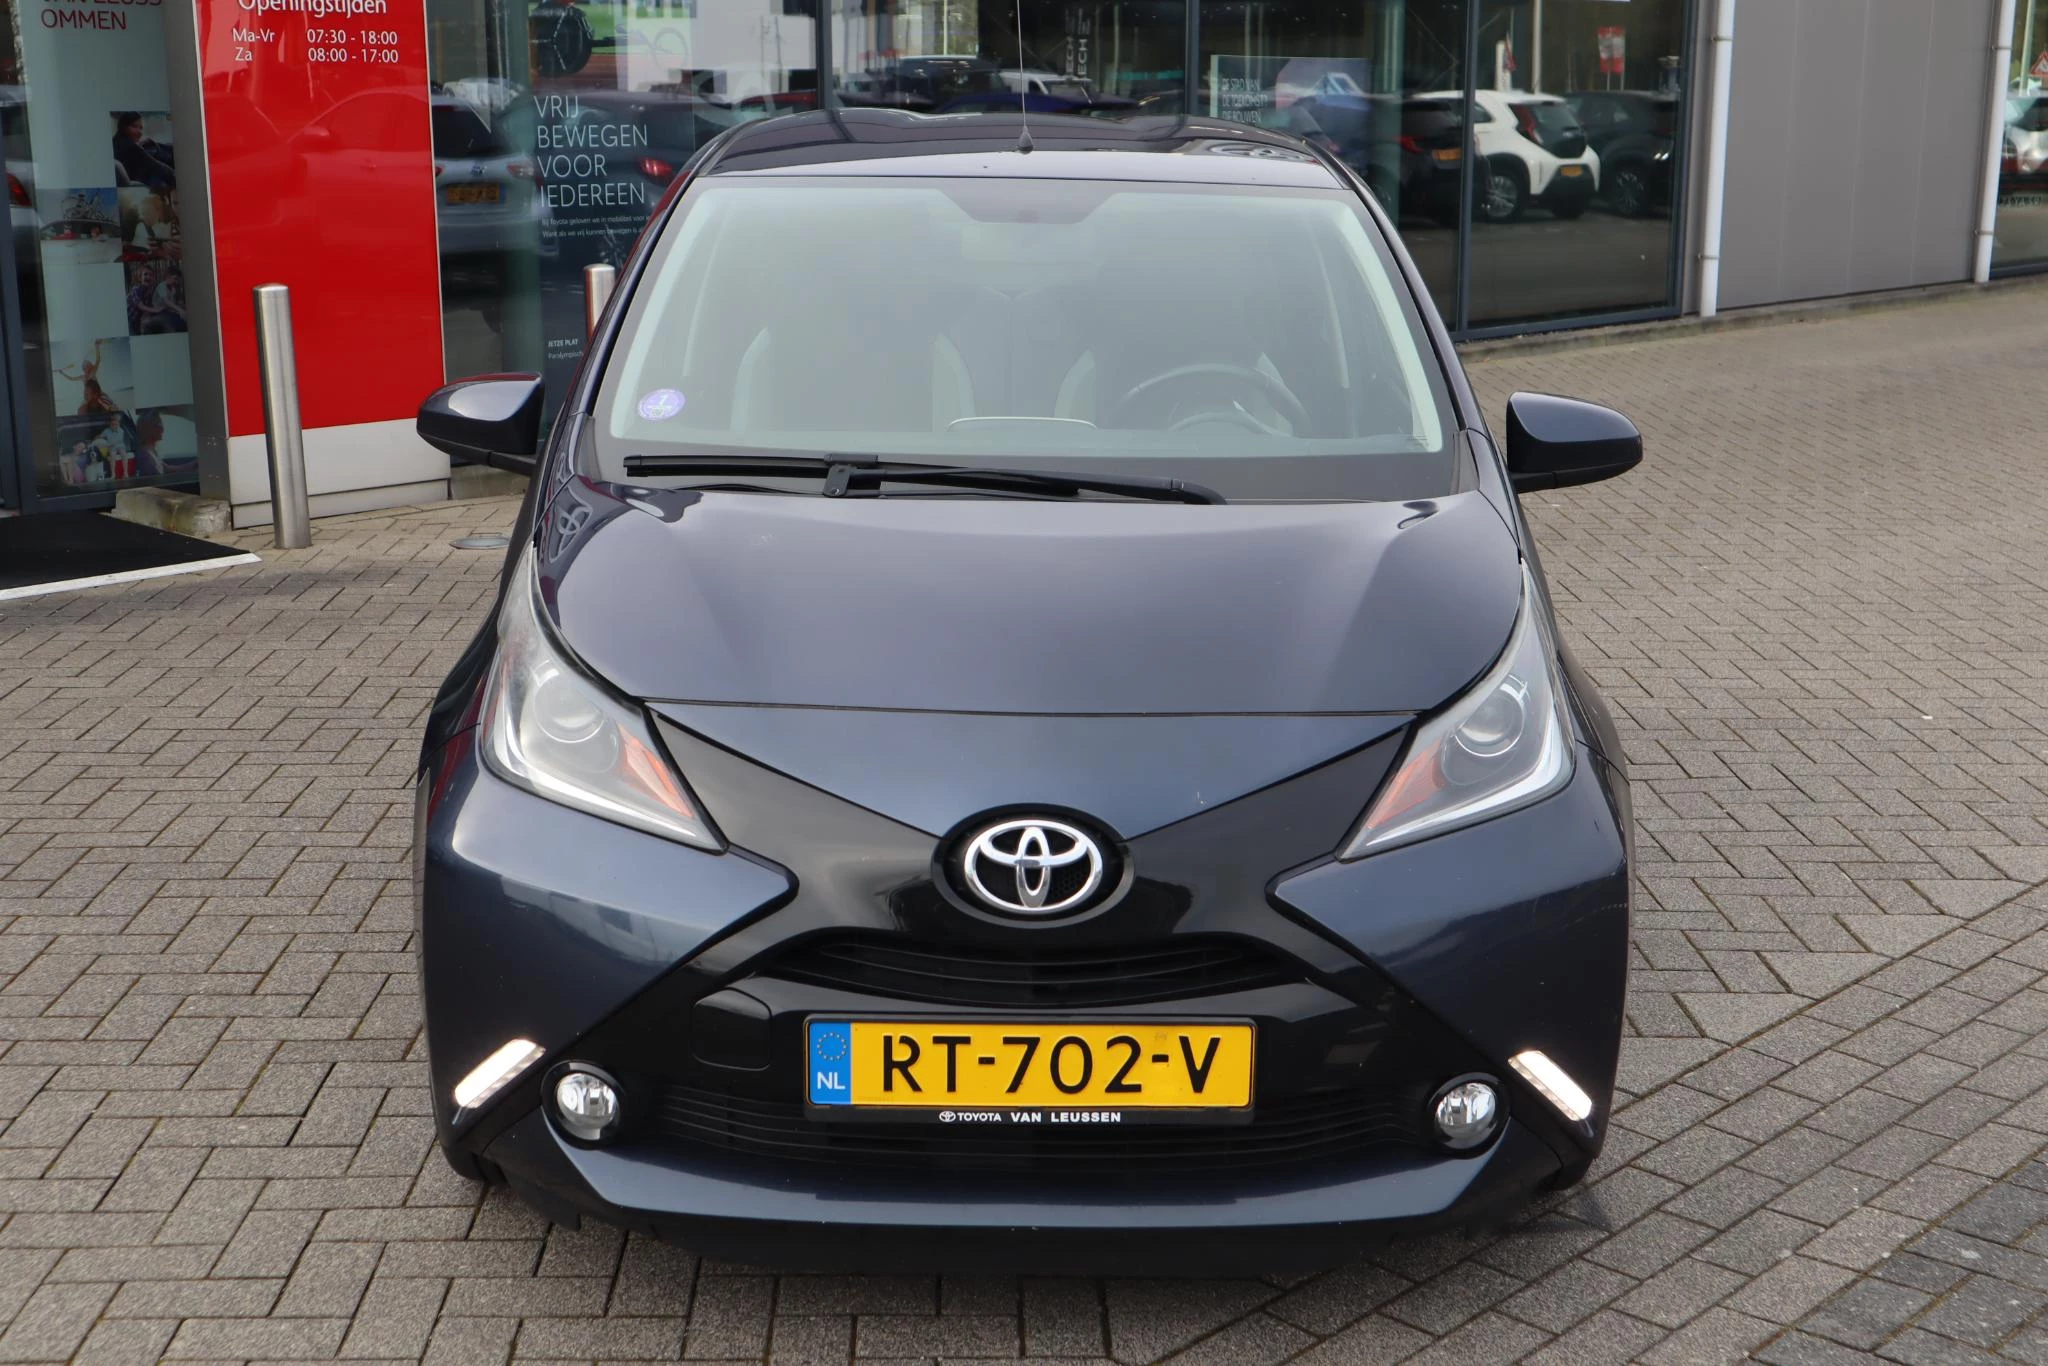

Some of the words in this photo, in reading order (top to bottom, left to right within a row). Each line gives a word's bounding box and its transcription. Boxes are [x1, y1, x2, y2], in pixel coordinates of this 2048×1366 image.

[41, 8, 127, 30] OMMEN
[239, 0, 387, 18] Openingstijden
[232, 28, 275, 43] Ma-Vr
[306, 29, 346, 44] 07:30
[360, 30, 398, 45] 18:00
[235, 47, 253, 61] Za
[308, 47, 347, 62] 08:00
[361, 49, 399, 63] 17:00
[533, 95, 579, 119] VRIJ
[536, 124, 648, 149] BEWEGEN
[537, 154, 608, 178] VOOR
[540, 182, 646, 208] IEDEREEN
[817, 1072, 846, 1090] NL
[882, 1034, 1221, 1095] RT-702-V
[958, 1112, 1002, 1122] TOYOTA
[1011, 1112, 1042, 1122] VAN
[1051, 1112, 1121, 1122] LEUSSEN
